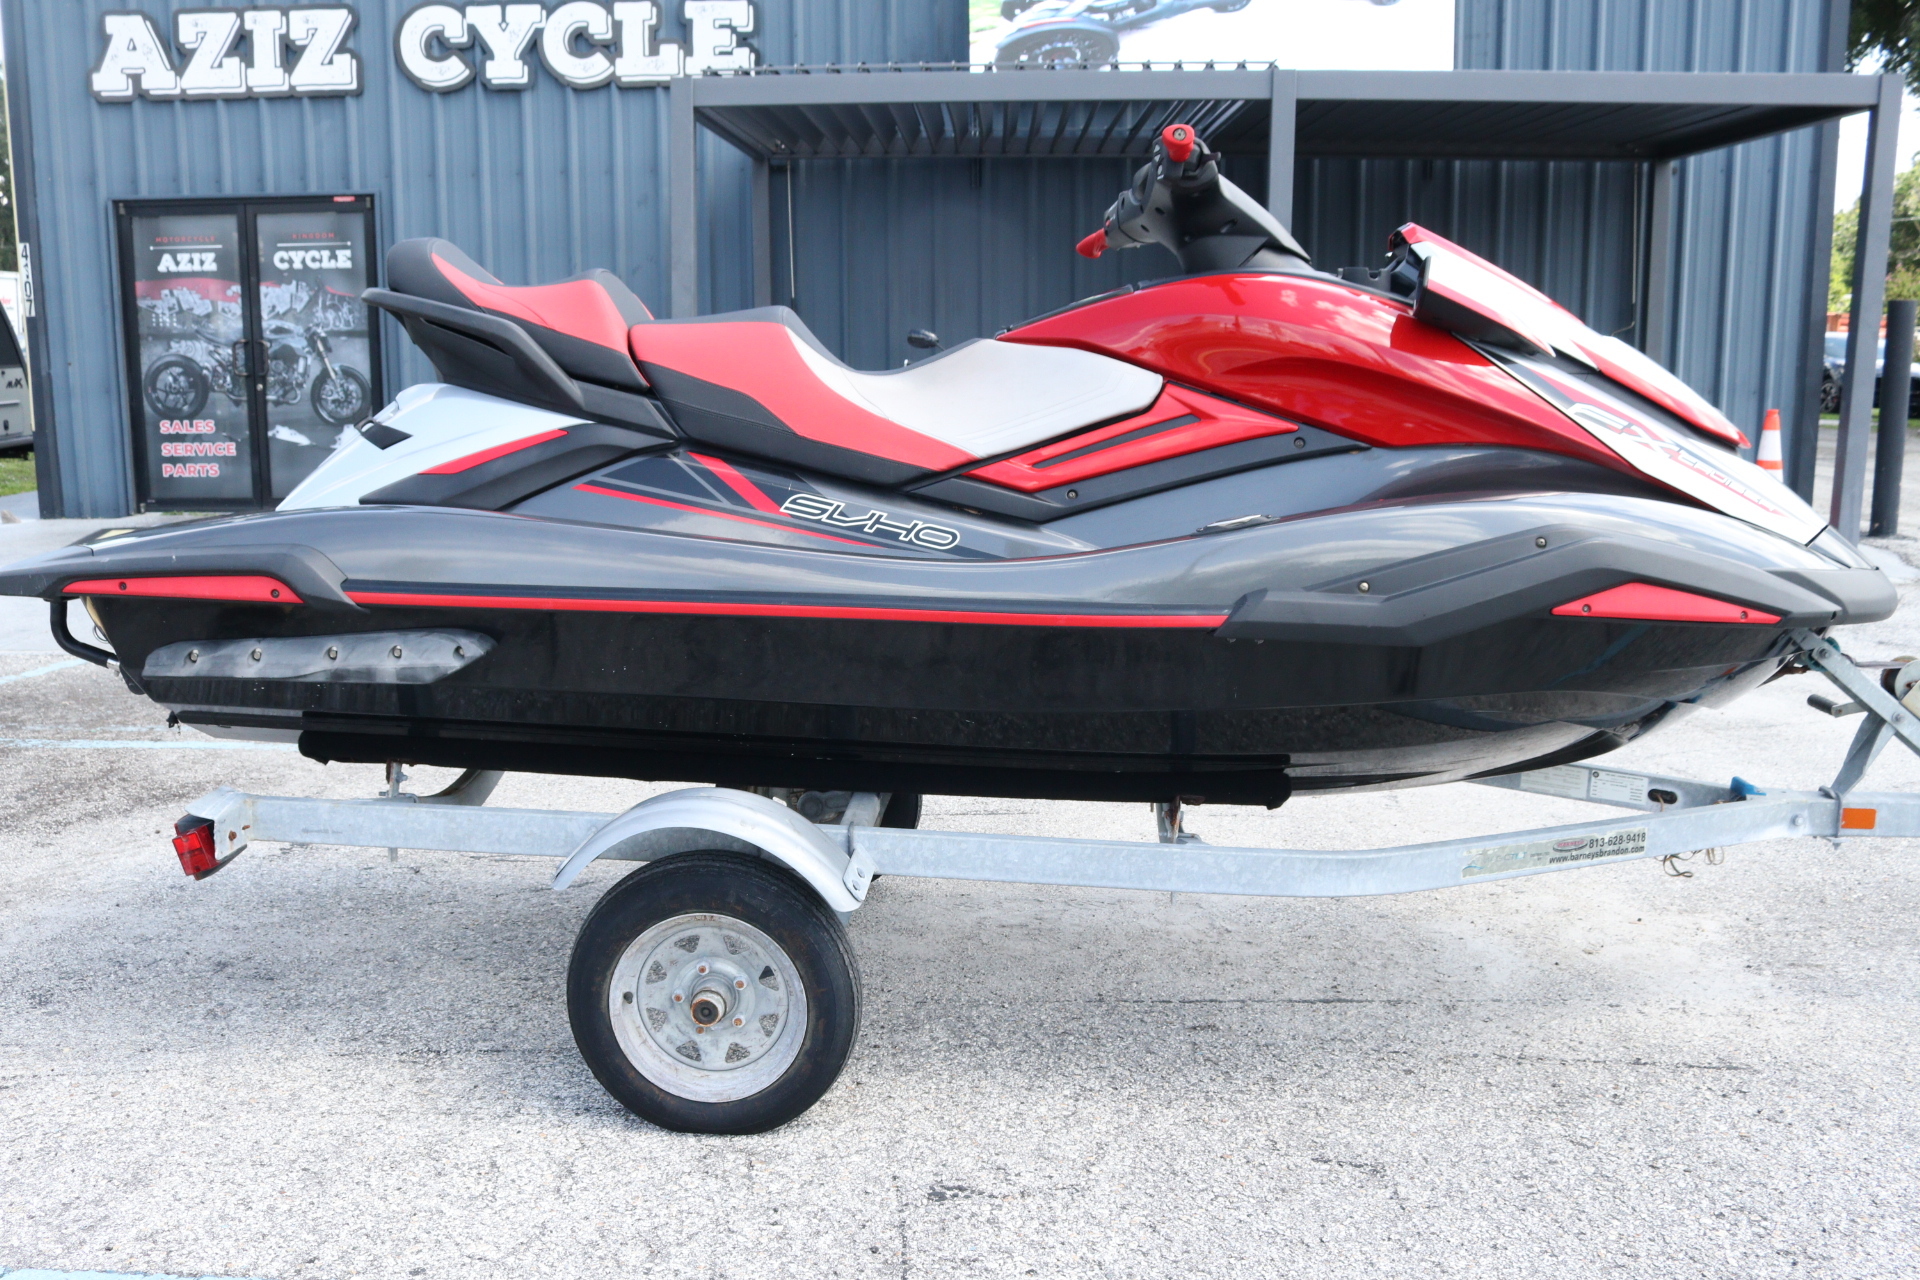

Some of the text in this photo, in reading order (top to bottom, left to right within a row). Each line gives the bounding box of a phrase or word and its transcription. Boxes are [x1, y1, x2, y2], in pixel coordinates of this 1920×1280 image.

[91, 0, 755, 97] AZIZ CYCLE
[155, 235, 216, 243] MOTORCYCLE
[157, 249, 353, 272] AZIZ CYCLE
[159, 419, 216, 434] SALES
[161, 442, 237, 457] SERVICE
[162, 462, 220, 478] PARTS
[779, 493, 961, 550] SVHO
[1588, 832, 1647, 849] 813-628-9418
[1549, 845, 1645, 864] www.barneysbrandon.com
